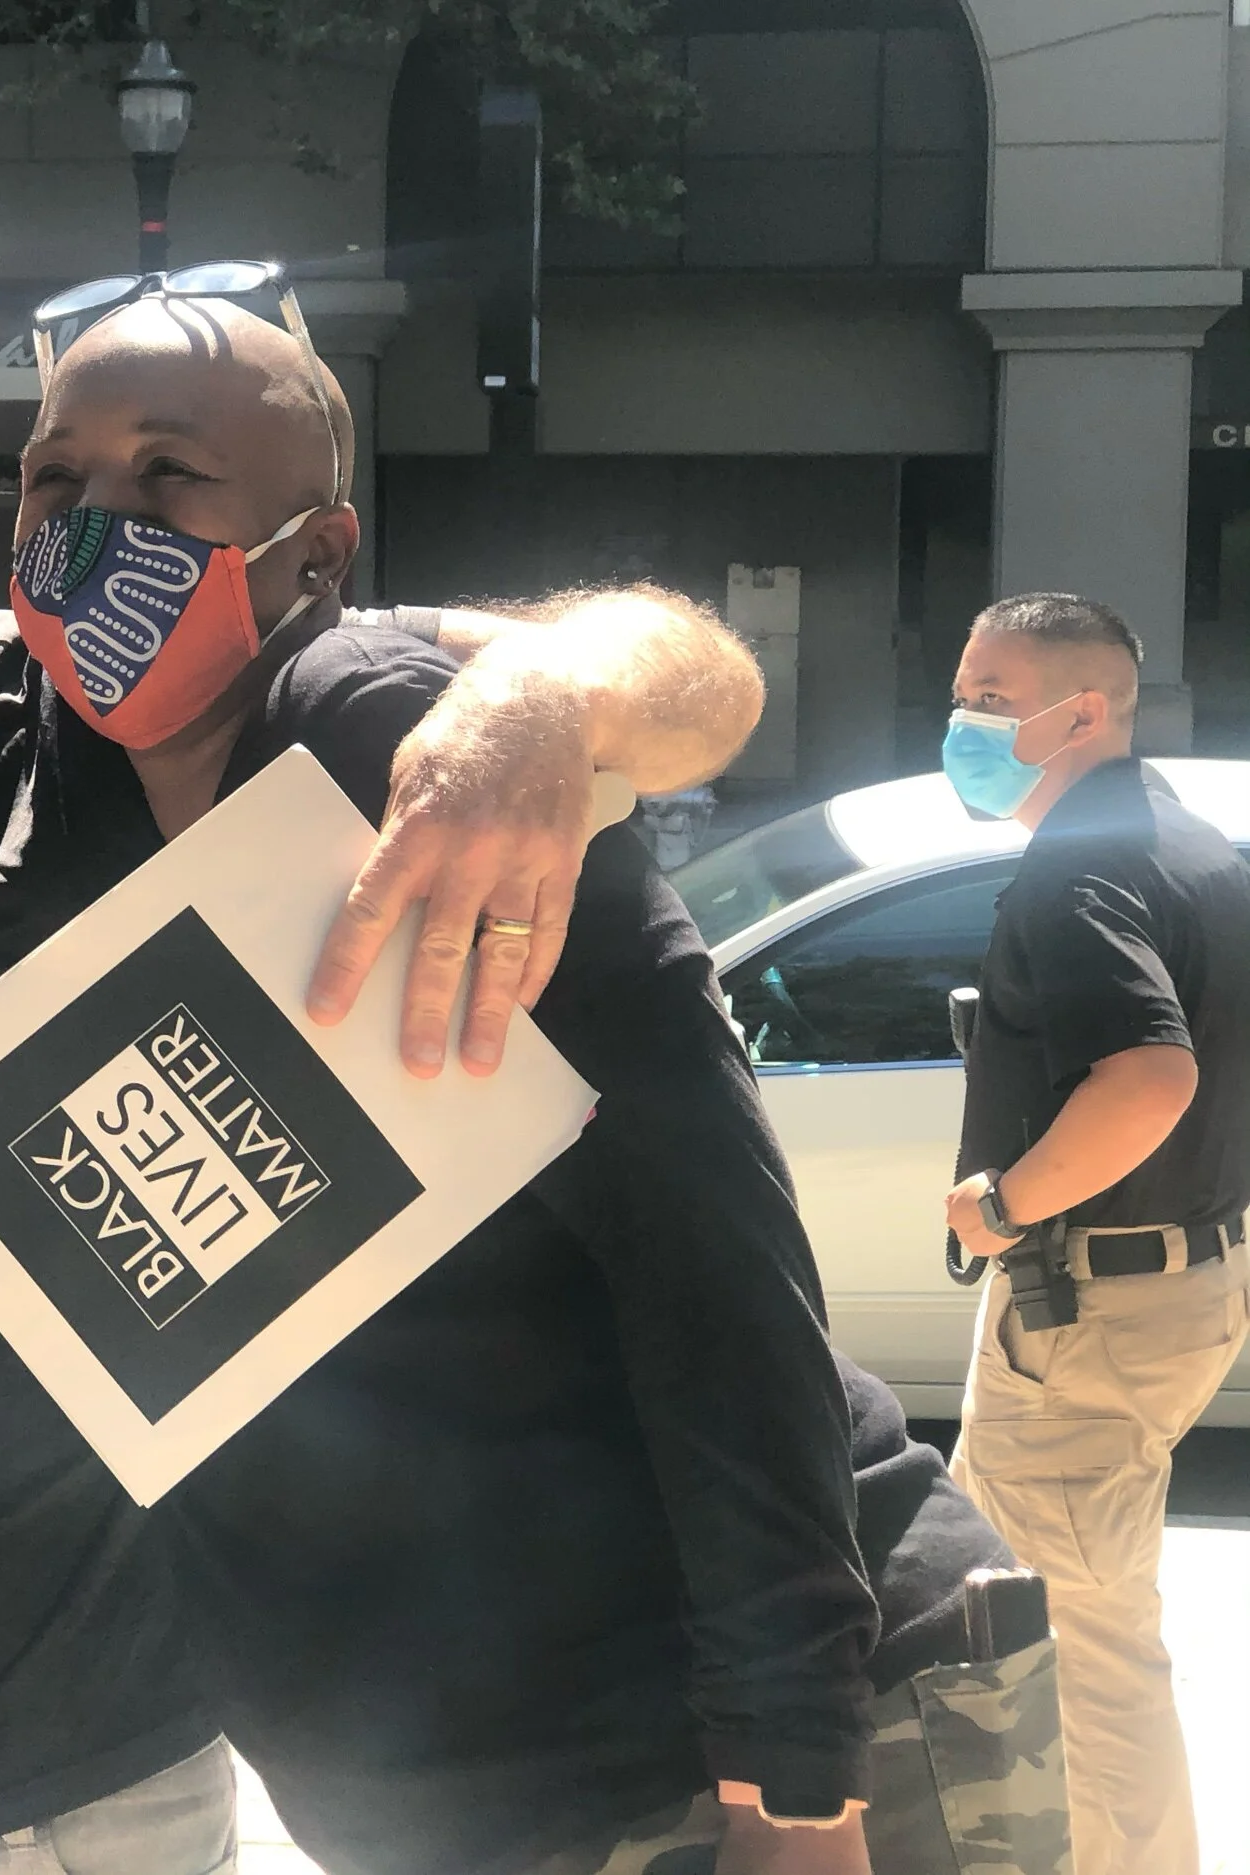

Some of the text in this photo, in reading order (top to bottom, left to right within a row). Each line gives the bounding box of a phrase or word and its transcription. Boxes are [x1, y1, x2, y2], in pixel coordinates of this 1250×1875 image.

[96, 1082, 249, 1251] LIVES
[151, 1014, 322, 1209] MATTER
[30, 1126, 185, 1299] BLACK
